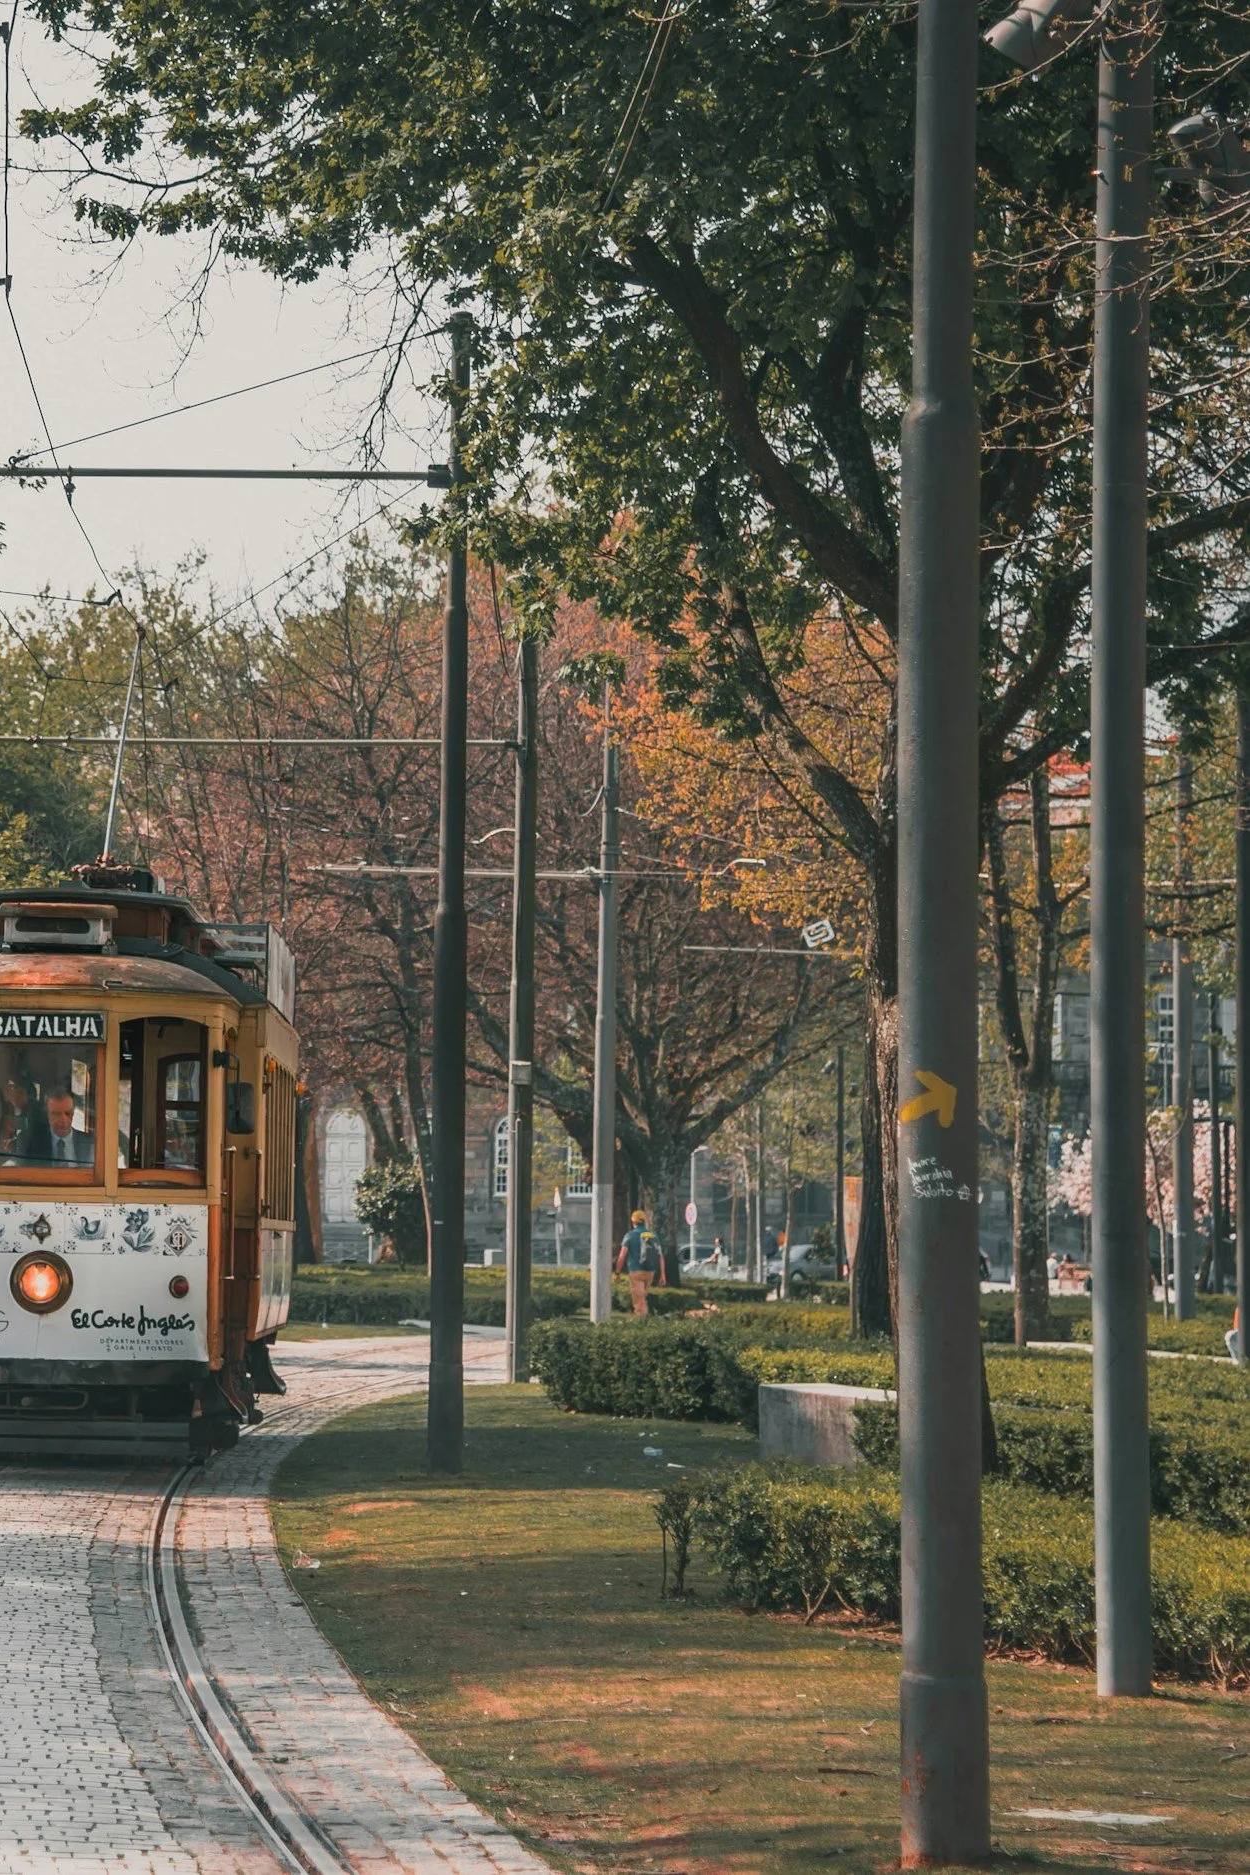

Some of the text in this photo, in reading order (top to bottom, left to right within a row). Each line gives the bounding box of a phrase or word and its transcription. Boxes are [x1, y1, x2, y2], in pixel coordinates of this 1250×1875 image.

[913, 1183, 954, 1199] Subito
[70, 1304, 196, 1336] El Corte Inglés
